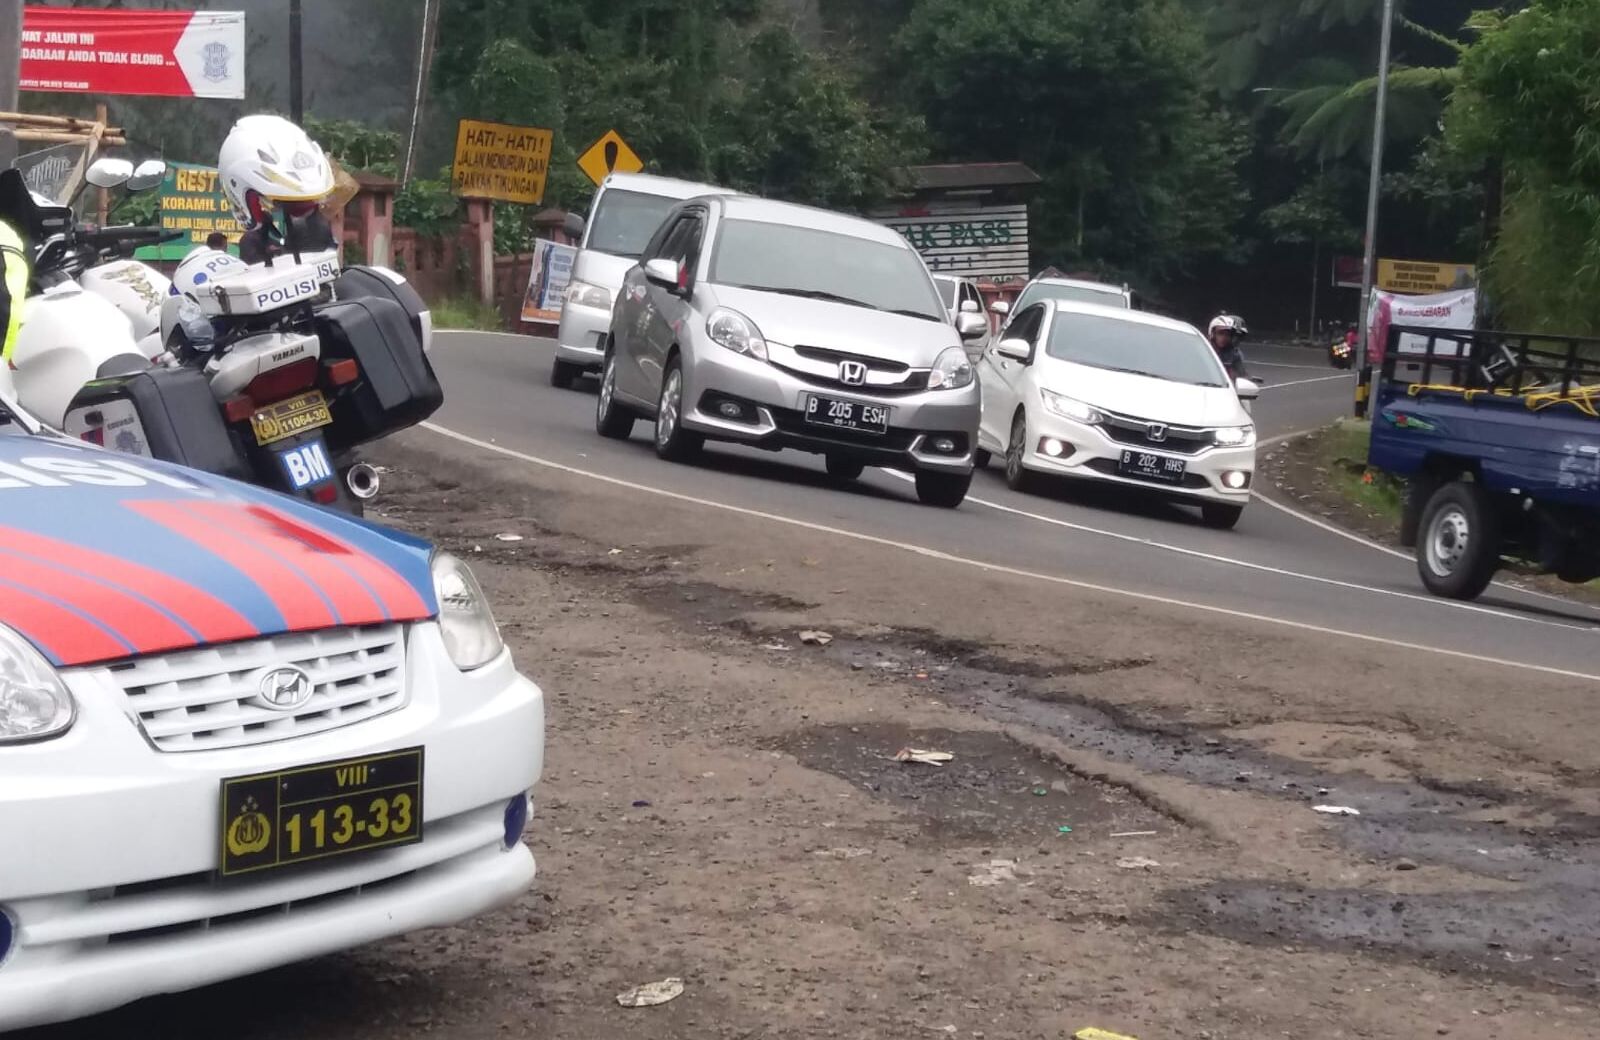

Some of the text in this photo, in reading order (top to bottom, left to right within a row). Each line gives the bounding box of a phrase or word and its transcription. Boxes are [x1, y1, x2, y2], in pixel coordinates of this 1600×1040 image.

[44, 32, 77, 44] JALUR
[79, 33, 94, 45] INI
[67, 50, 96, 62] ANDA
[98, 51, 128, 64] TIDAK
[130, 53, 164, 65] BLONG
[458, 150, 484, 168] JALAN
[527, 157, 545, 174] DAN
[177, 168, 218, 192] REST
[458, 171, 537, 195] BANYAK TIKUNGAN
[162, 197, 216, 211] KORAMIL
[949, 220, 1012, 247] PASS
[257, 279, 317, 307] POLISI
[272, 344, 304, 362] YAMAHA
[809, 397, 818, 413] B
[828, 401, 853, 419] 205
[862, 406, 887, 424] ESH
[0, 457, 200, 488] ISI
[284, 444, 331, 487] BM
[1123, 451, 1131, 463] B
[1138, 454, 1157, 468] 202
[1164, 458, 1184, 472] HHS
[336, 765, 368, 787] VIII
[286, 793, 411, 853] 113-33
